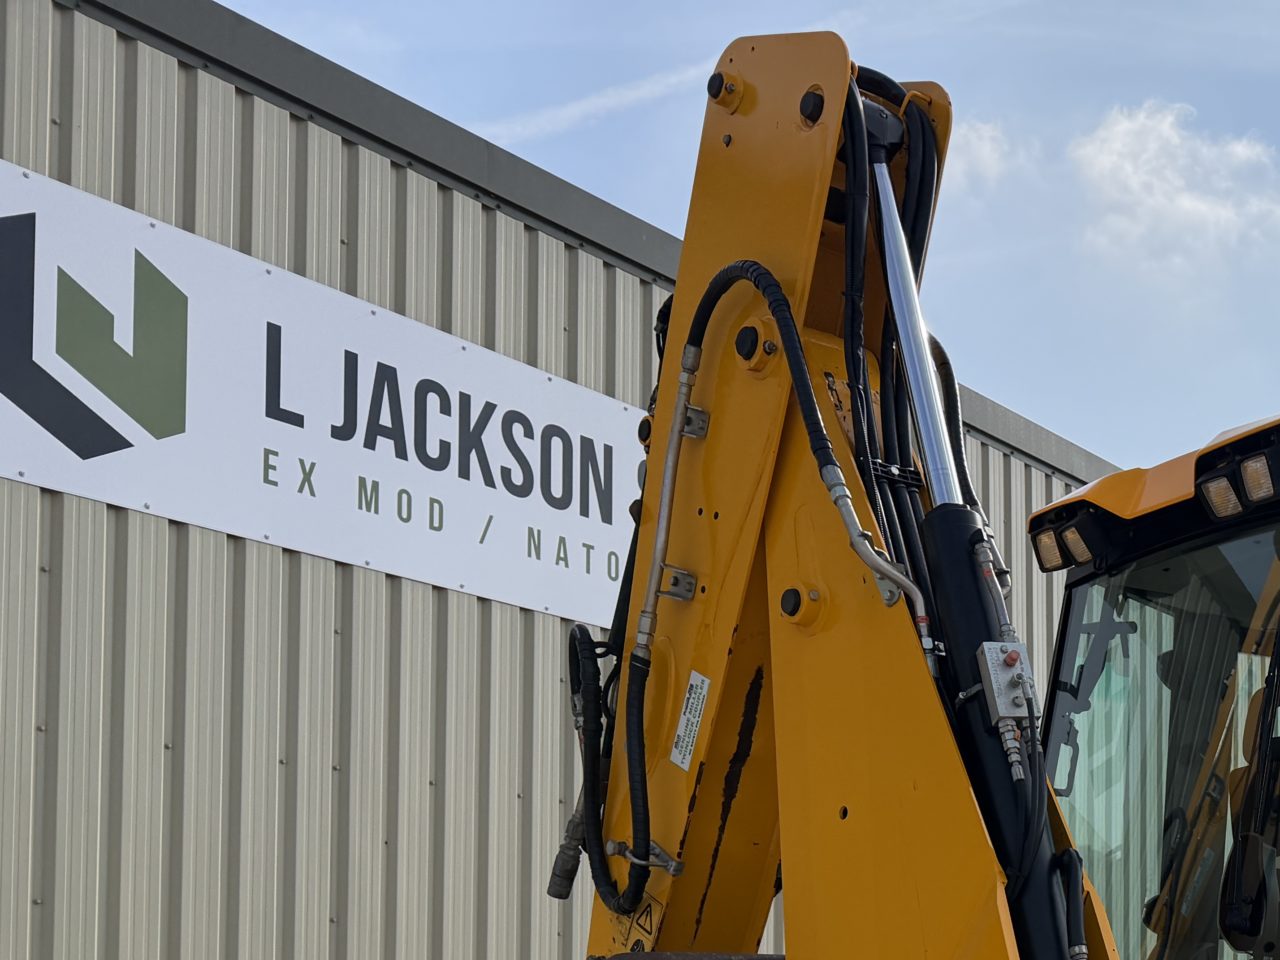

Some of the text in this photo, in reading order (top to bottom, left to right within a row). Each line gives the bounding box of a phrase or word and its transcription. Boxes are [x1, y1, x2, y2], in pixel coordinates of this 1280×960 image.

[265, 321, 613, 525] L JACKSON
[263, 447, 317, 498] EX
[357, 476, 443, 532] MOD
[527, 527, 620, 582] NATO
[692, 679, 705, 719] COUPLER
